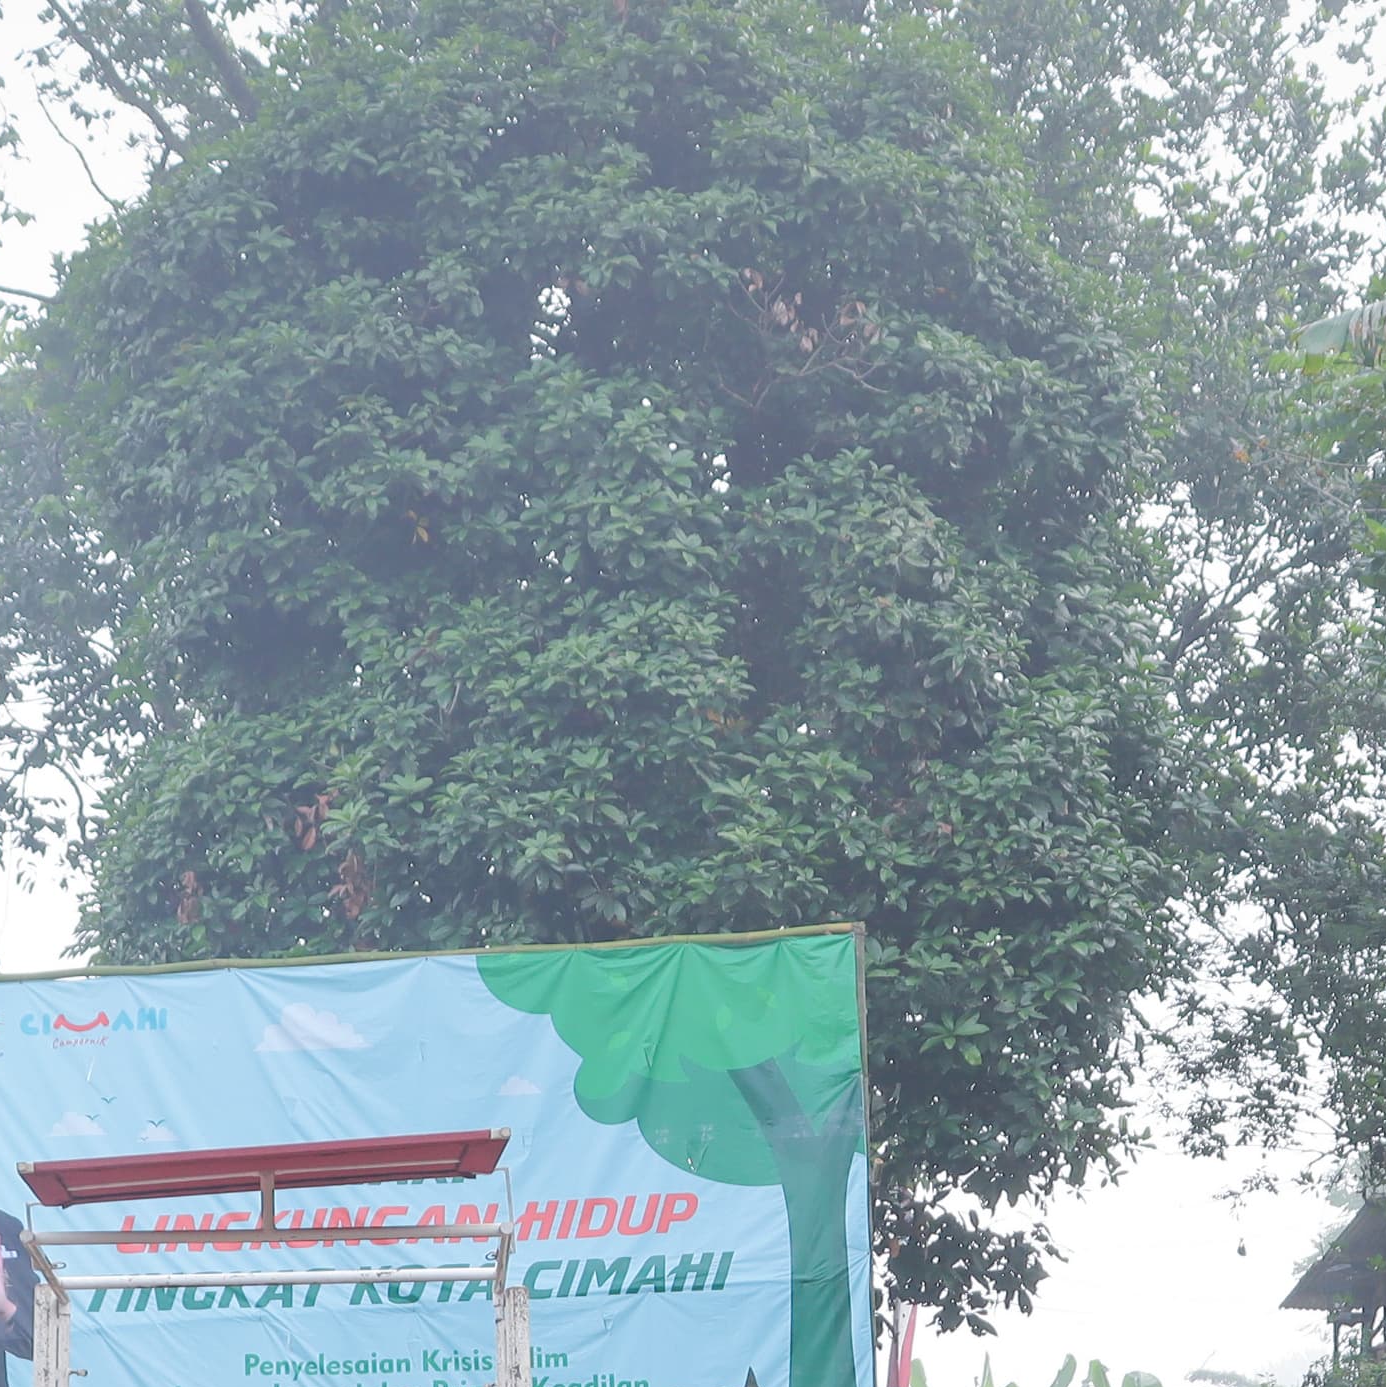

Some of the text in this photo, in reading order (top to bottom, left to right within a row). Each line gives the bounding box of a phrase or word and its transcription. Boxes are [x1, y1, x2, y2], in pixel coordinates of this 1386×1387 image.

[514, 1192, 699, 1241] HIDUP
[87, 1250, 734, 1312] TINGKAT KOTA CIMAHI
[244, 1347, 569, 1381] Penyelesaian Krisis lim
